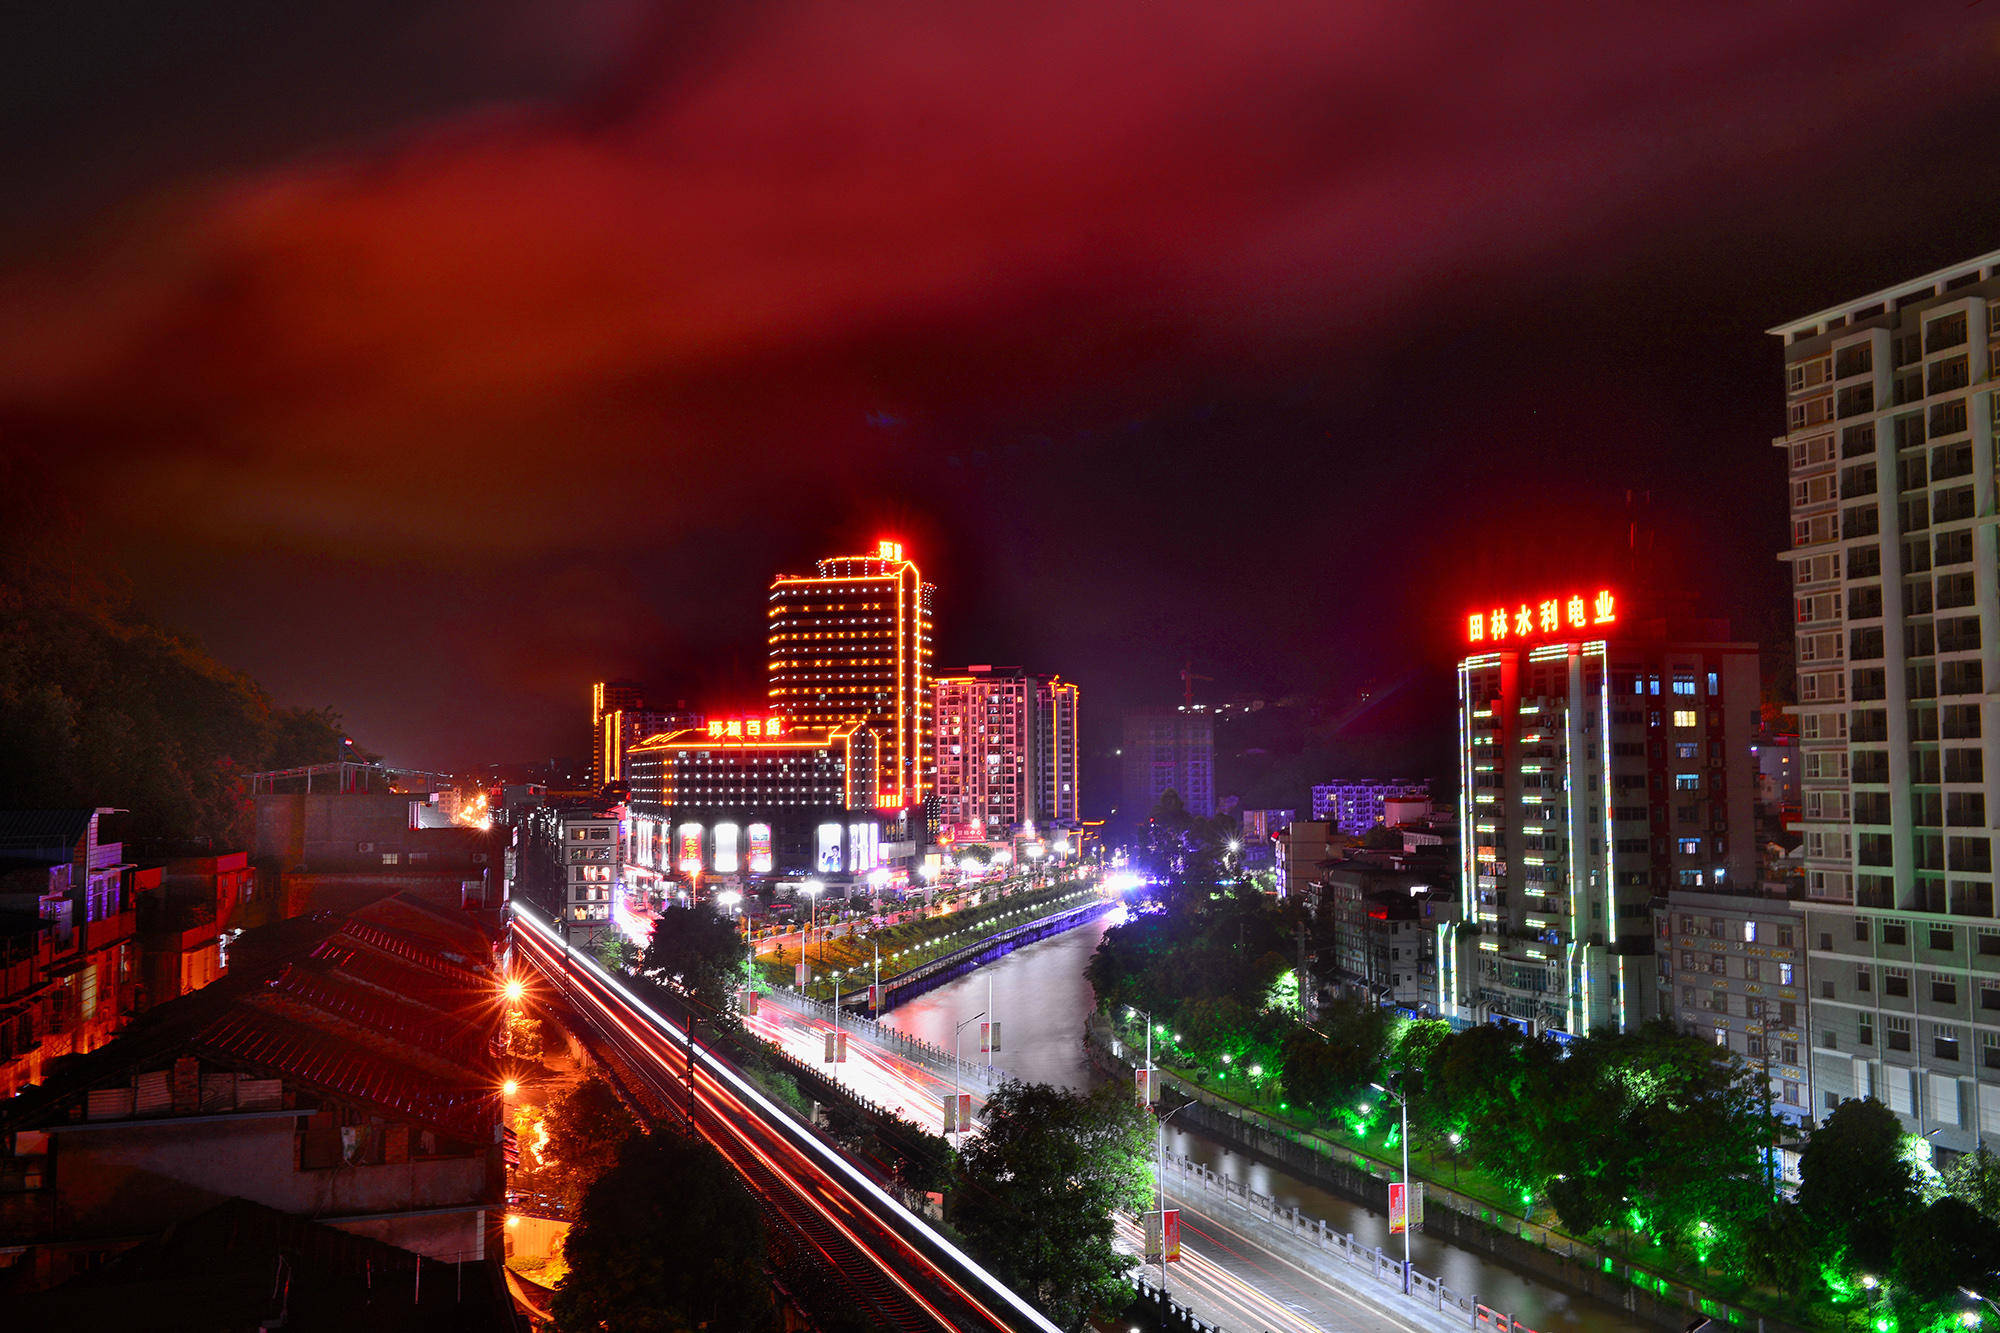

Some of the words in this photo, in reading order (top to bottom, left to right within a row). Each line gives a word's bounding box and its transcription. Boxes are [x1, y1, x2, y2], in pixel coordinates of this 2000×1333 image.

[1469, 590, 1615, 642] 田林水利电业
